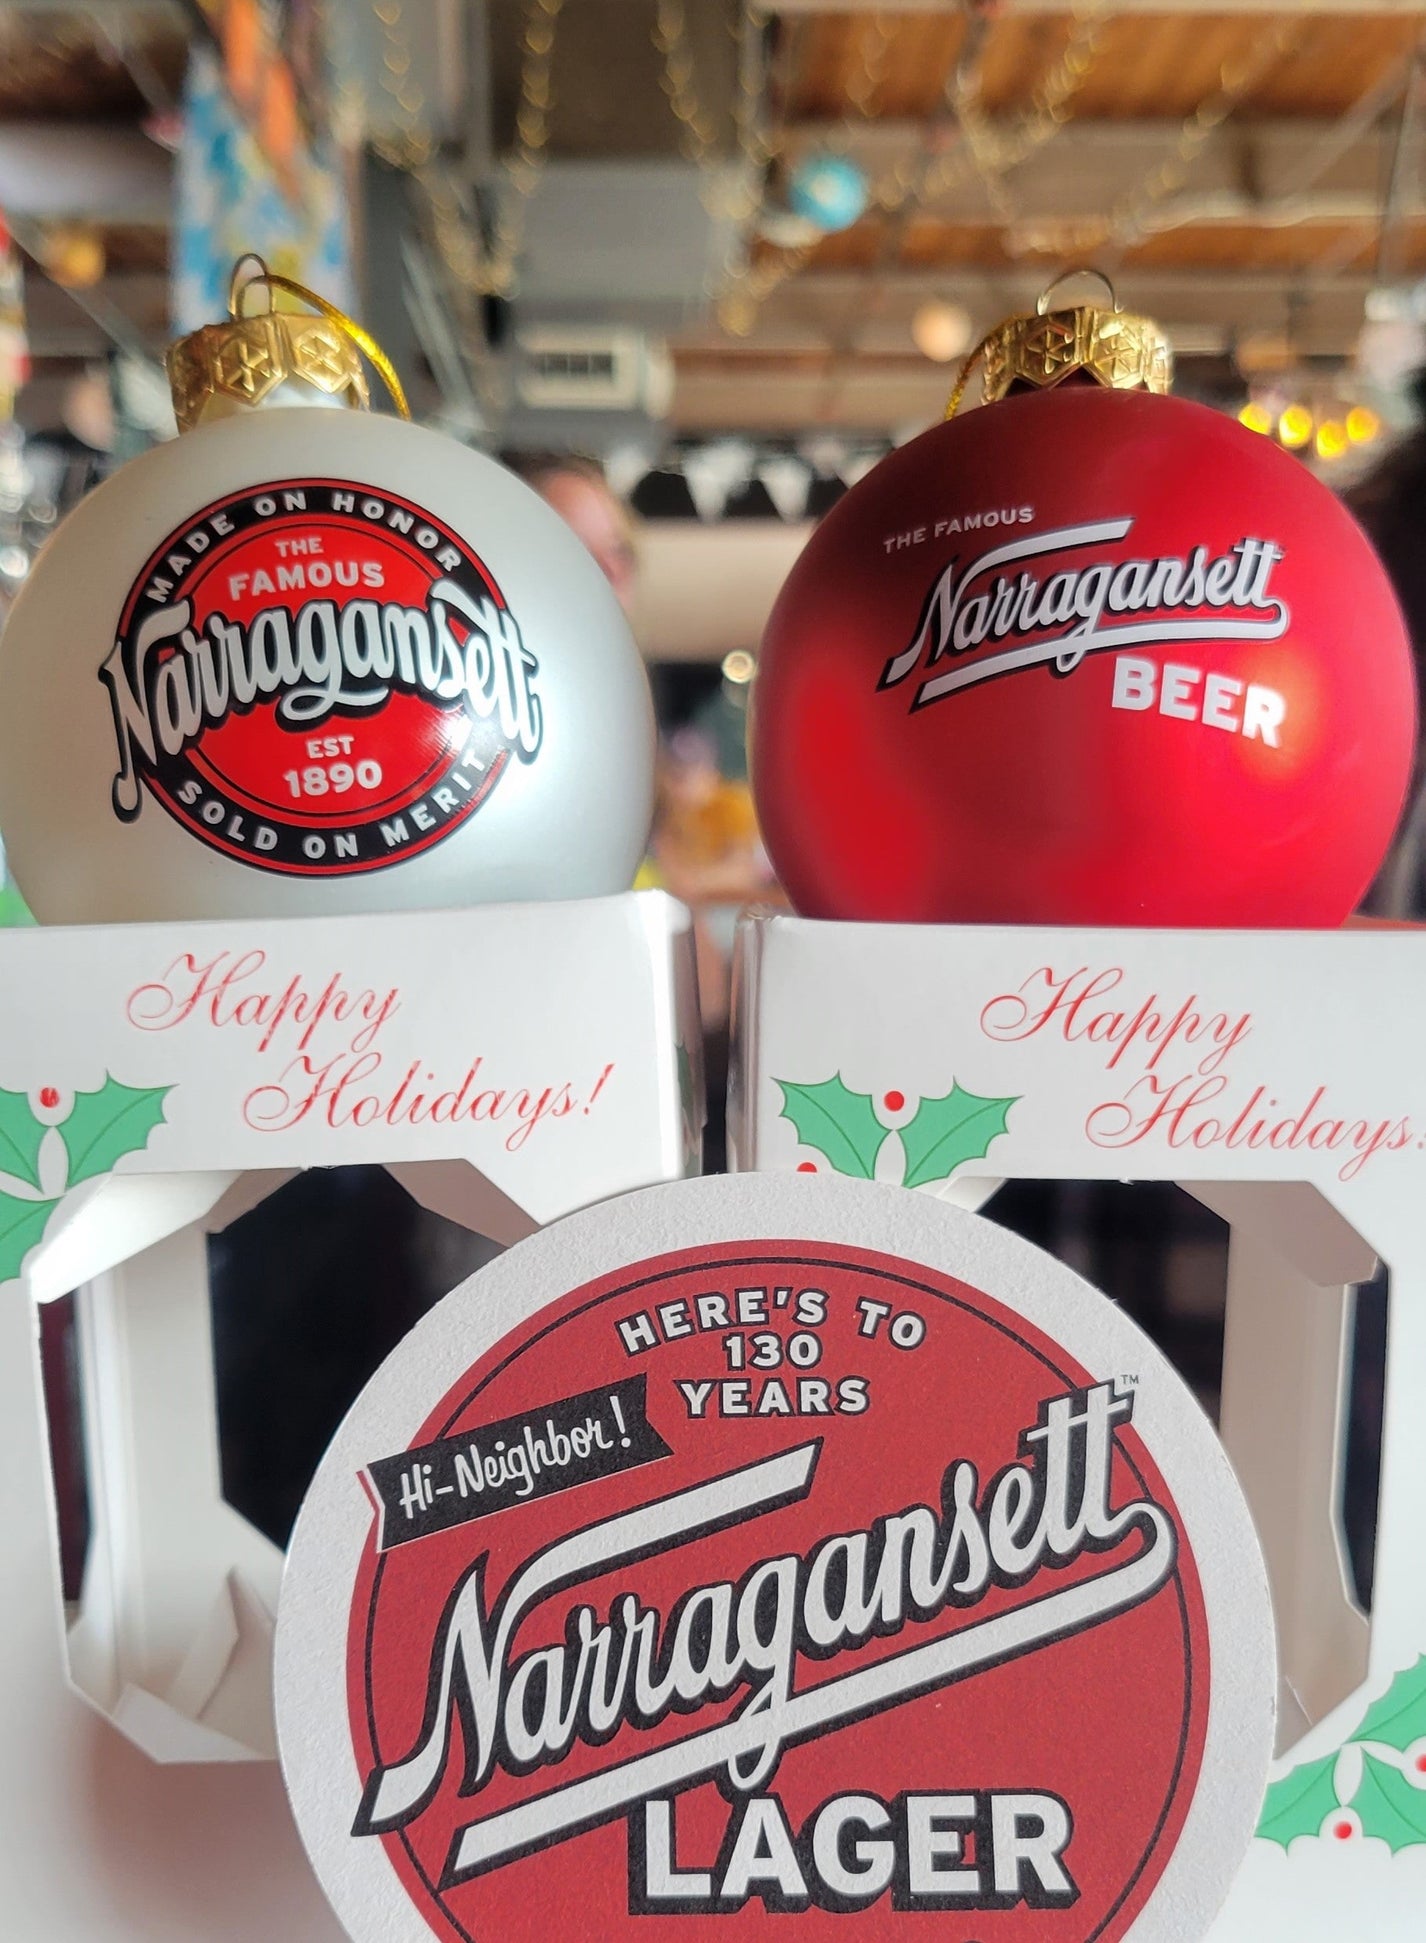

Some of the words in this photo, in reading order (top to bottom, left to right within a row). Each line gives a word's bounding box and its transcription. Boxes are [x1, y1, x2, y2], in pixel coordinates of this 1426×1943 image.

[146, 512, 235, 603] MADE
[254, 491, 307, 517] ON
[332, 493, 462, 573] HONOR
[275, 537, 323, 558] THE
[883, 528, 925, 554] THE
[934, 506, 1035, 537] FAMOUS
[228, 561, 385, 601] FAMOUS
[877, 517, 1290, 713] Narragansett
[100, 577, 543, 821] Narragansett
[306, 735, 354, 759] EST
[1111, 656, 1285, 748] BEER
[176, 779, 278, 851] SOLD
[304, 833, 358, 859] ON
[384, 747, 487, 848] MERIT
[284, 760, 383, 798] 1890
[126, 949, 402, 1053] Happy
[979, 966, 1253, 1076] Happy
[243, 1051, 615, 1151] Holidays!
[1085, 1075, 1426, 1182] Holidays
[614, 1287, 830, 1356] HERE'S
[857, 1297, 927, 1352] TO
[722, 1331, 823, 1371] 130
[675, 1377, 871, 1418] YEARS
[351, 1378, 1179, 1891] Narragansett
[635, 1789, 1079, 1910] LAGER
